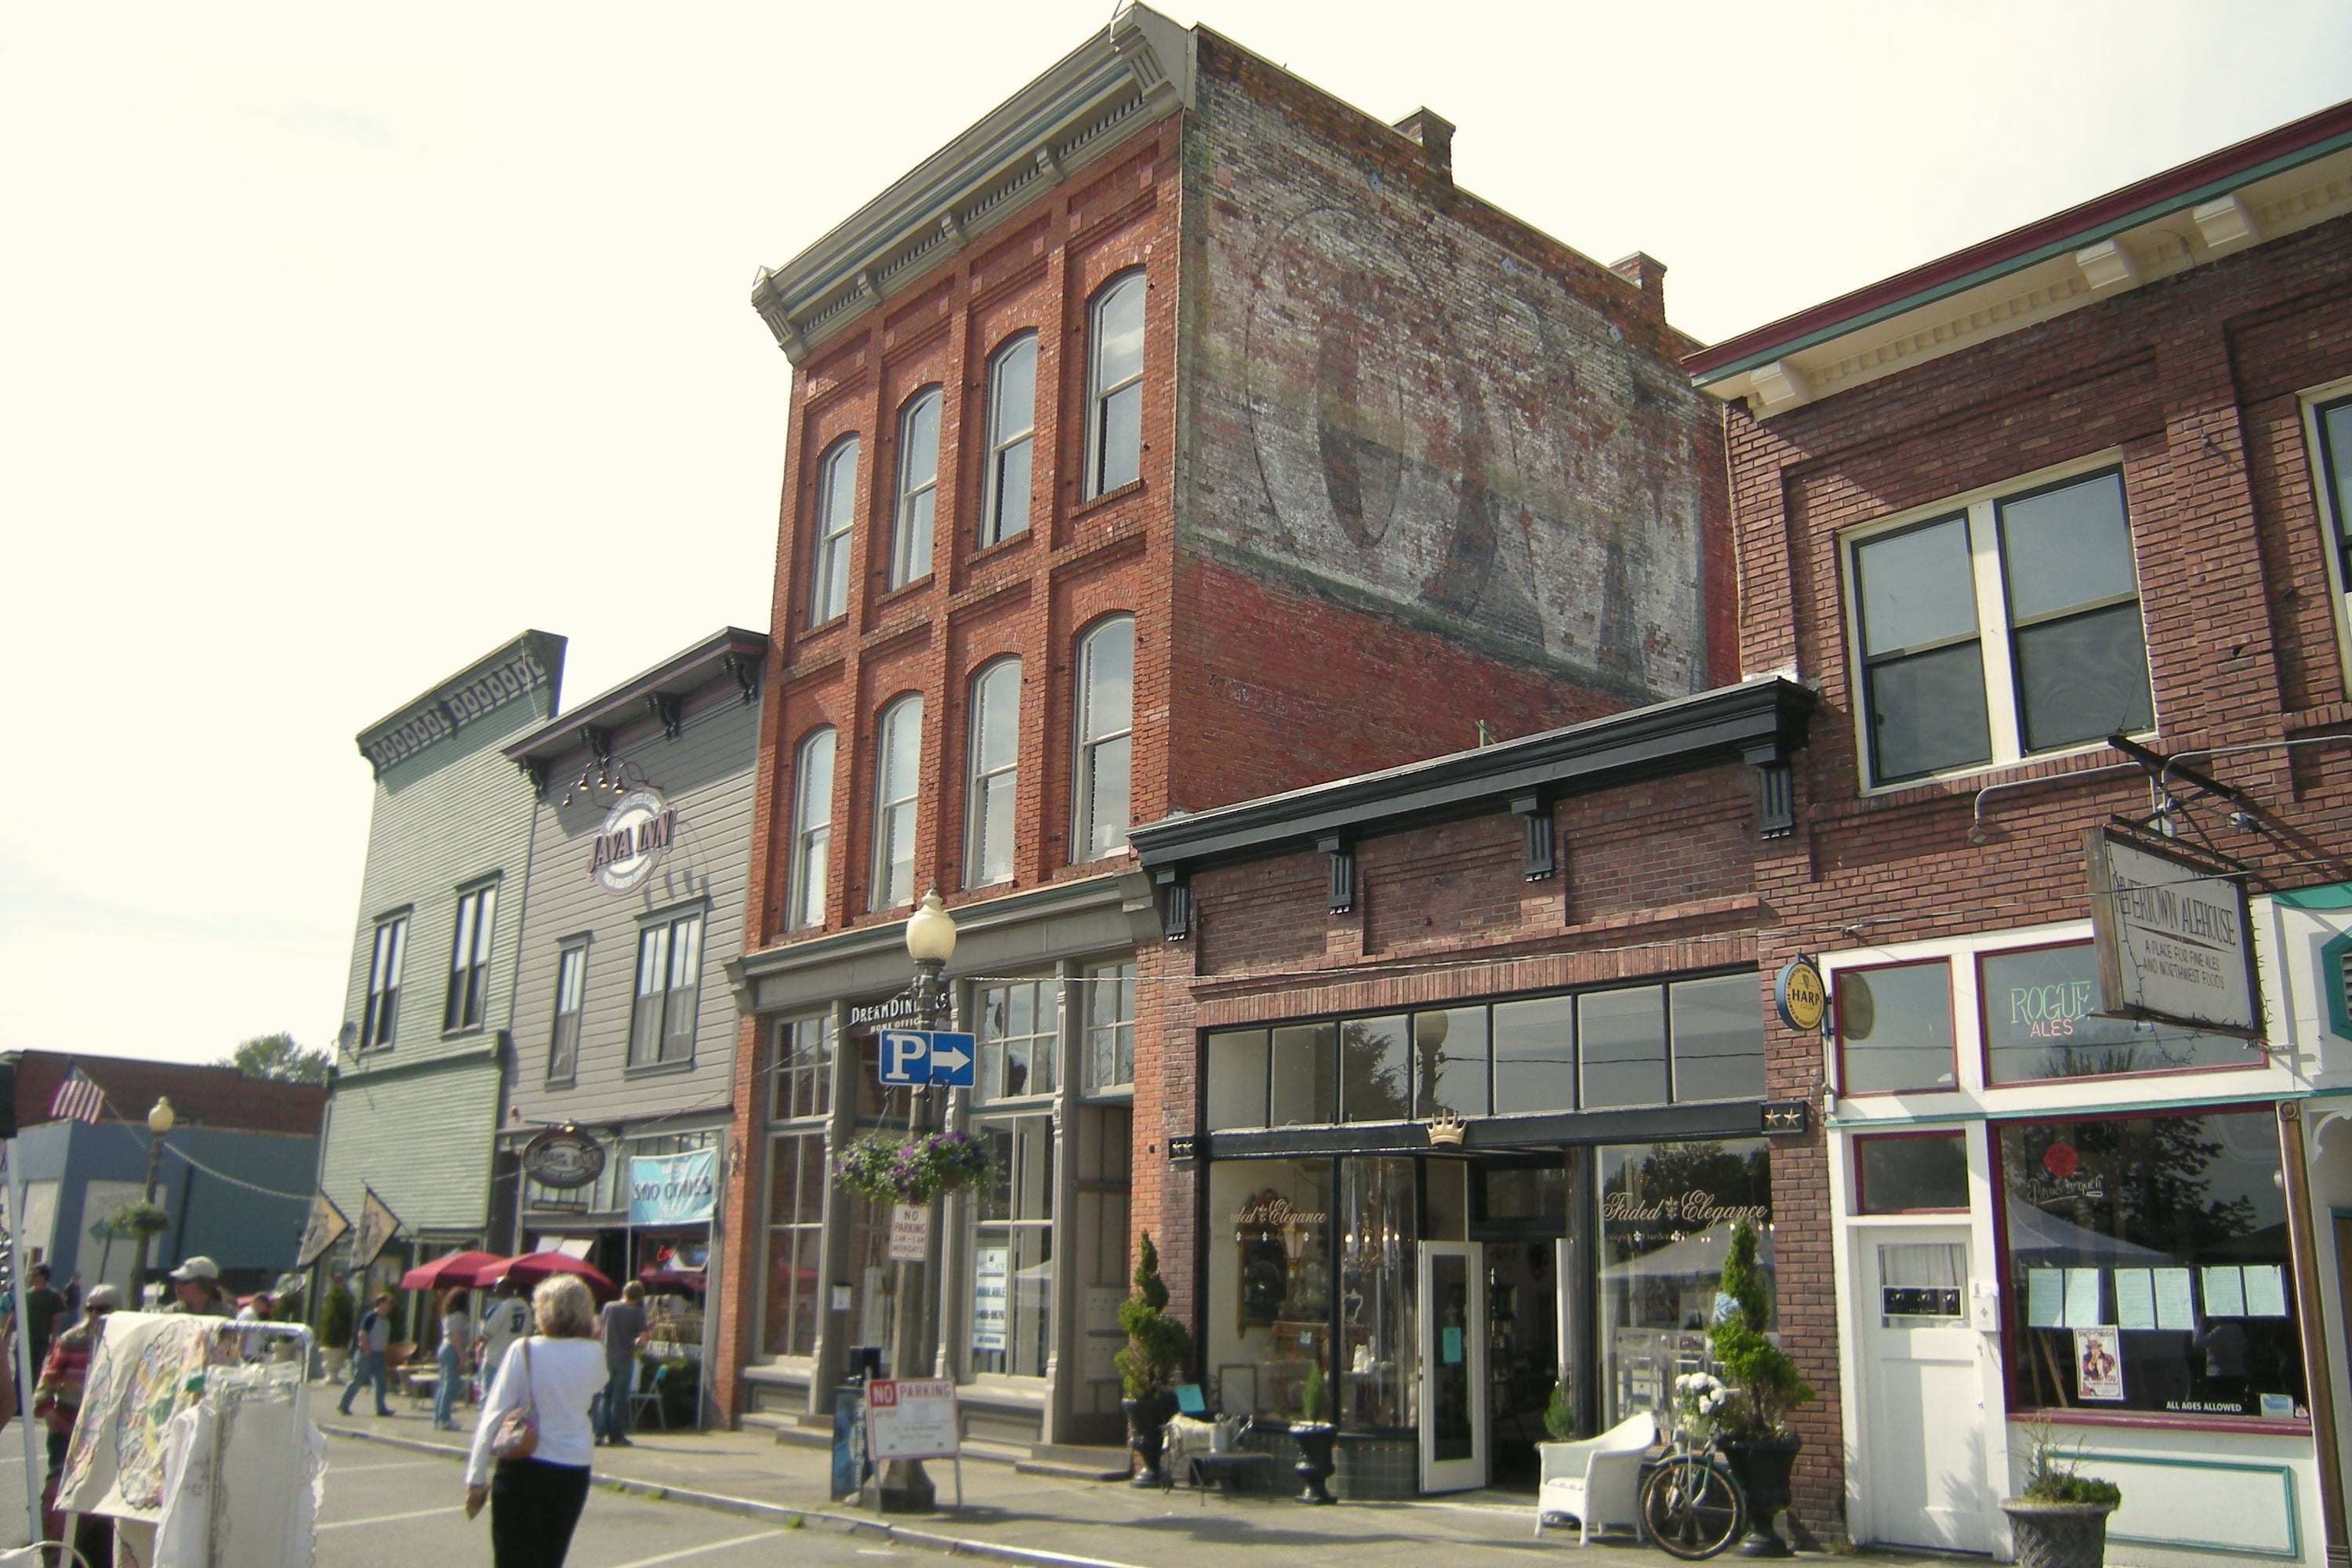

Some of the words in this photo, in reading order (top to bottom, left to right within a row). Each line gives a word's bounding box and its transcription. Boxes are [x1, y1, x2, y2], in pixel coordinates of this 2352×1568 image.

[587, 826, 632, 874] JAVA
[636, 808, 676, 853] INN
[2182, 897, 2236, 946] ALEHOUSE
[2145, 939, 2150, 953] A
[2152, 941, 2172, 959] PLACE
[2175, 946, 2187, 961] FOR
[2190, 949, 2204, 967] FINE
[2205, 956, 2220, 971] ALES
[2143, 956, 2157, 974] AND
[2159, 960, 2201, 984] NORTHWEST
[2202, 971, 2225, 990] FOODS
[1791, 988, 1820, 1007] HARP
[2009, 980, 2094, 1025] ROGUE
[870, 1022, 891, 1033] HOME
[895, 1017, 920, 1029] OFFIC
[2030, 1018, 2074, 1038] ALES
[886, 1034, 927, 1080] P
[905, 1210, 919, 1221] NO
[1269, 1199, 1327, 1228] Elegance
[1603, 1192, 1665, 1221] Faded
[1681, 1189, 1768, 1230] Elegance
[895, 1222, 926, 1235] PARKING
[2078, 1329, 2114, 1338] SNOHOMISH
[873, 1385, 894, 1403] NO
[899, 1385, 952, 1399] PARKING
[2166, 1401, 2180, 1410] ALL
[2181, 1401, 2201, 1410] AGES
[2203, 1402, 2242, 1412] ALLOWED
